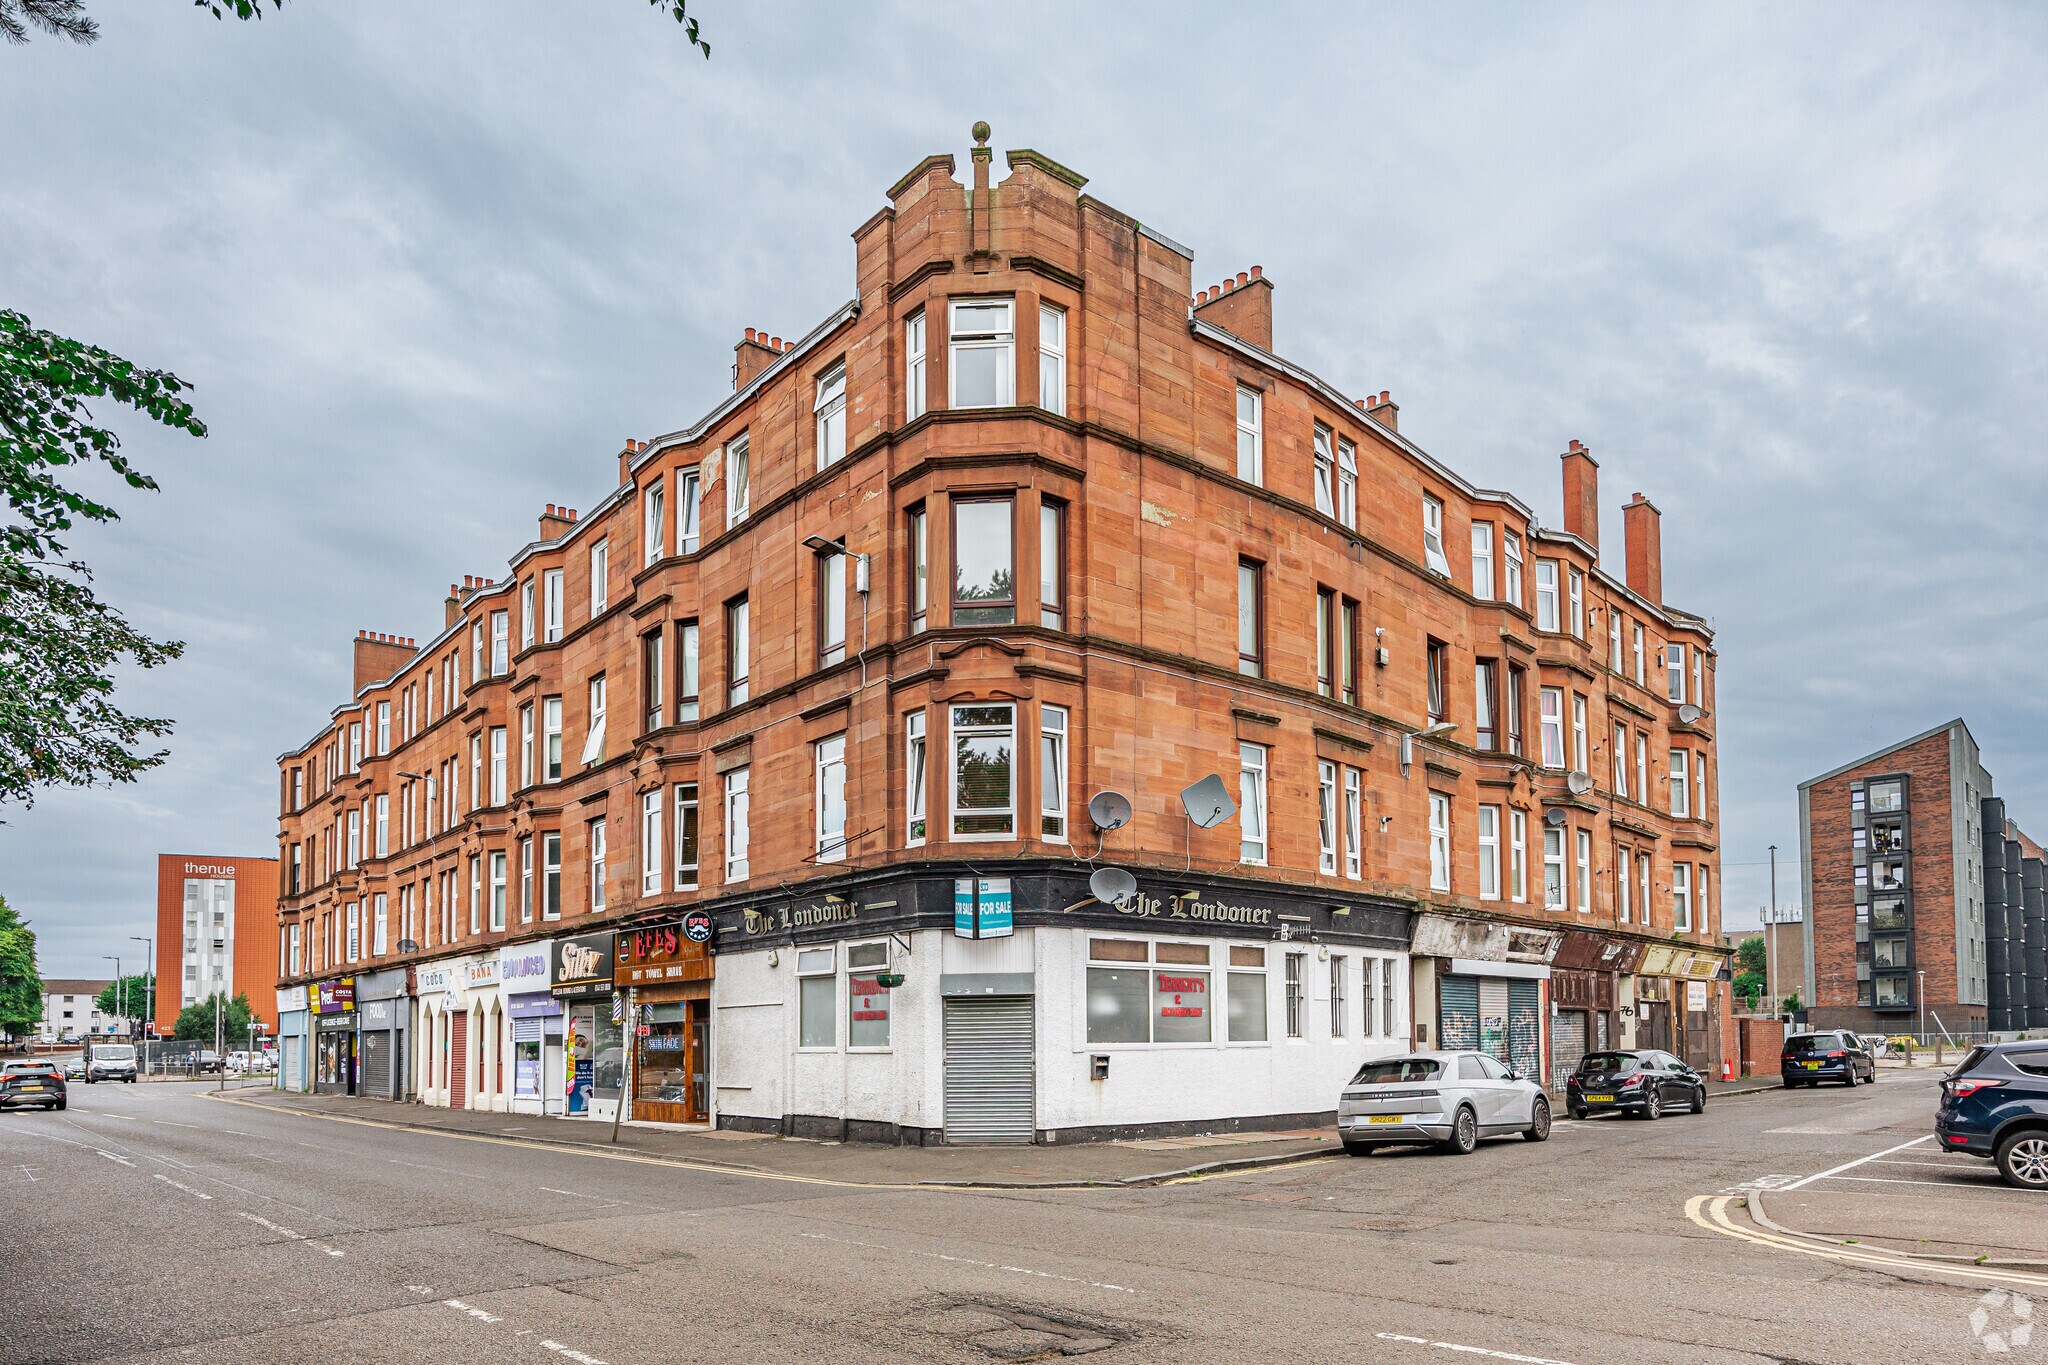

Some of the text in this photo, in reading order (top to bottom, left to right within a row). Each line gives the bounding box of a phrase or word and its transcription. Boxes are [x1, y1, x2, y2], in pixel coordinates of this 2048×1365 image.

[185, 862, 235, 875] thenue
[963, 903, 973, 915] SALE
[980, 901, 1011, 915] FOR SALE
[1114, 891, 1272, 924] The Londoner
[689, 918, 710, 927] EFES
[744, 901, 859, 936] The Londoner
[635, 926, 676, 957] EFES
[471, 966, 491, 980] BANA
[502, 955, 545, 980] ENHANCED
[632, 966, 682, 980] HOT TOWEL SHAVE
[425, 974, 443, 986] COCO
[1158, 974, 1205, 993] TENNENT'S
[1619, 1005, 1634, 1017] 76
[648, 1037, 679, 1050] SKIN FADE
